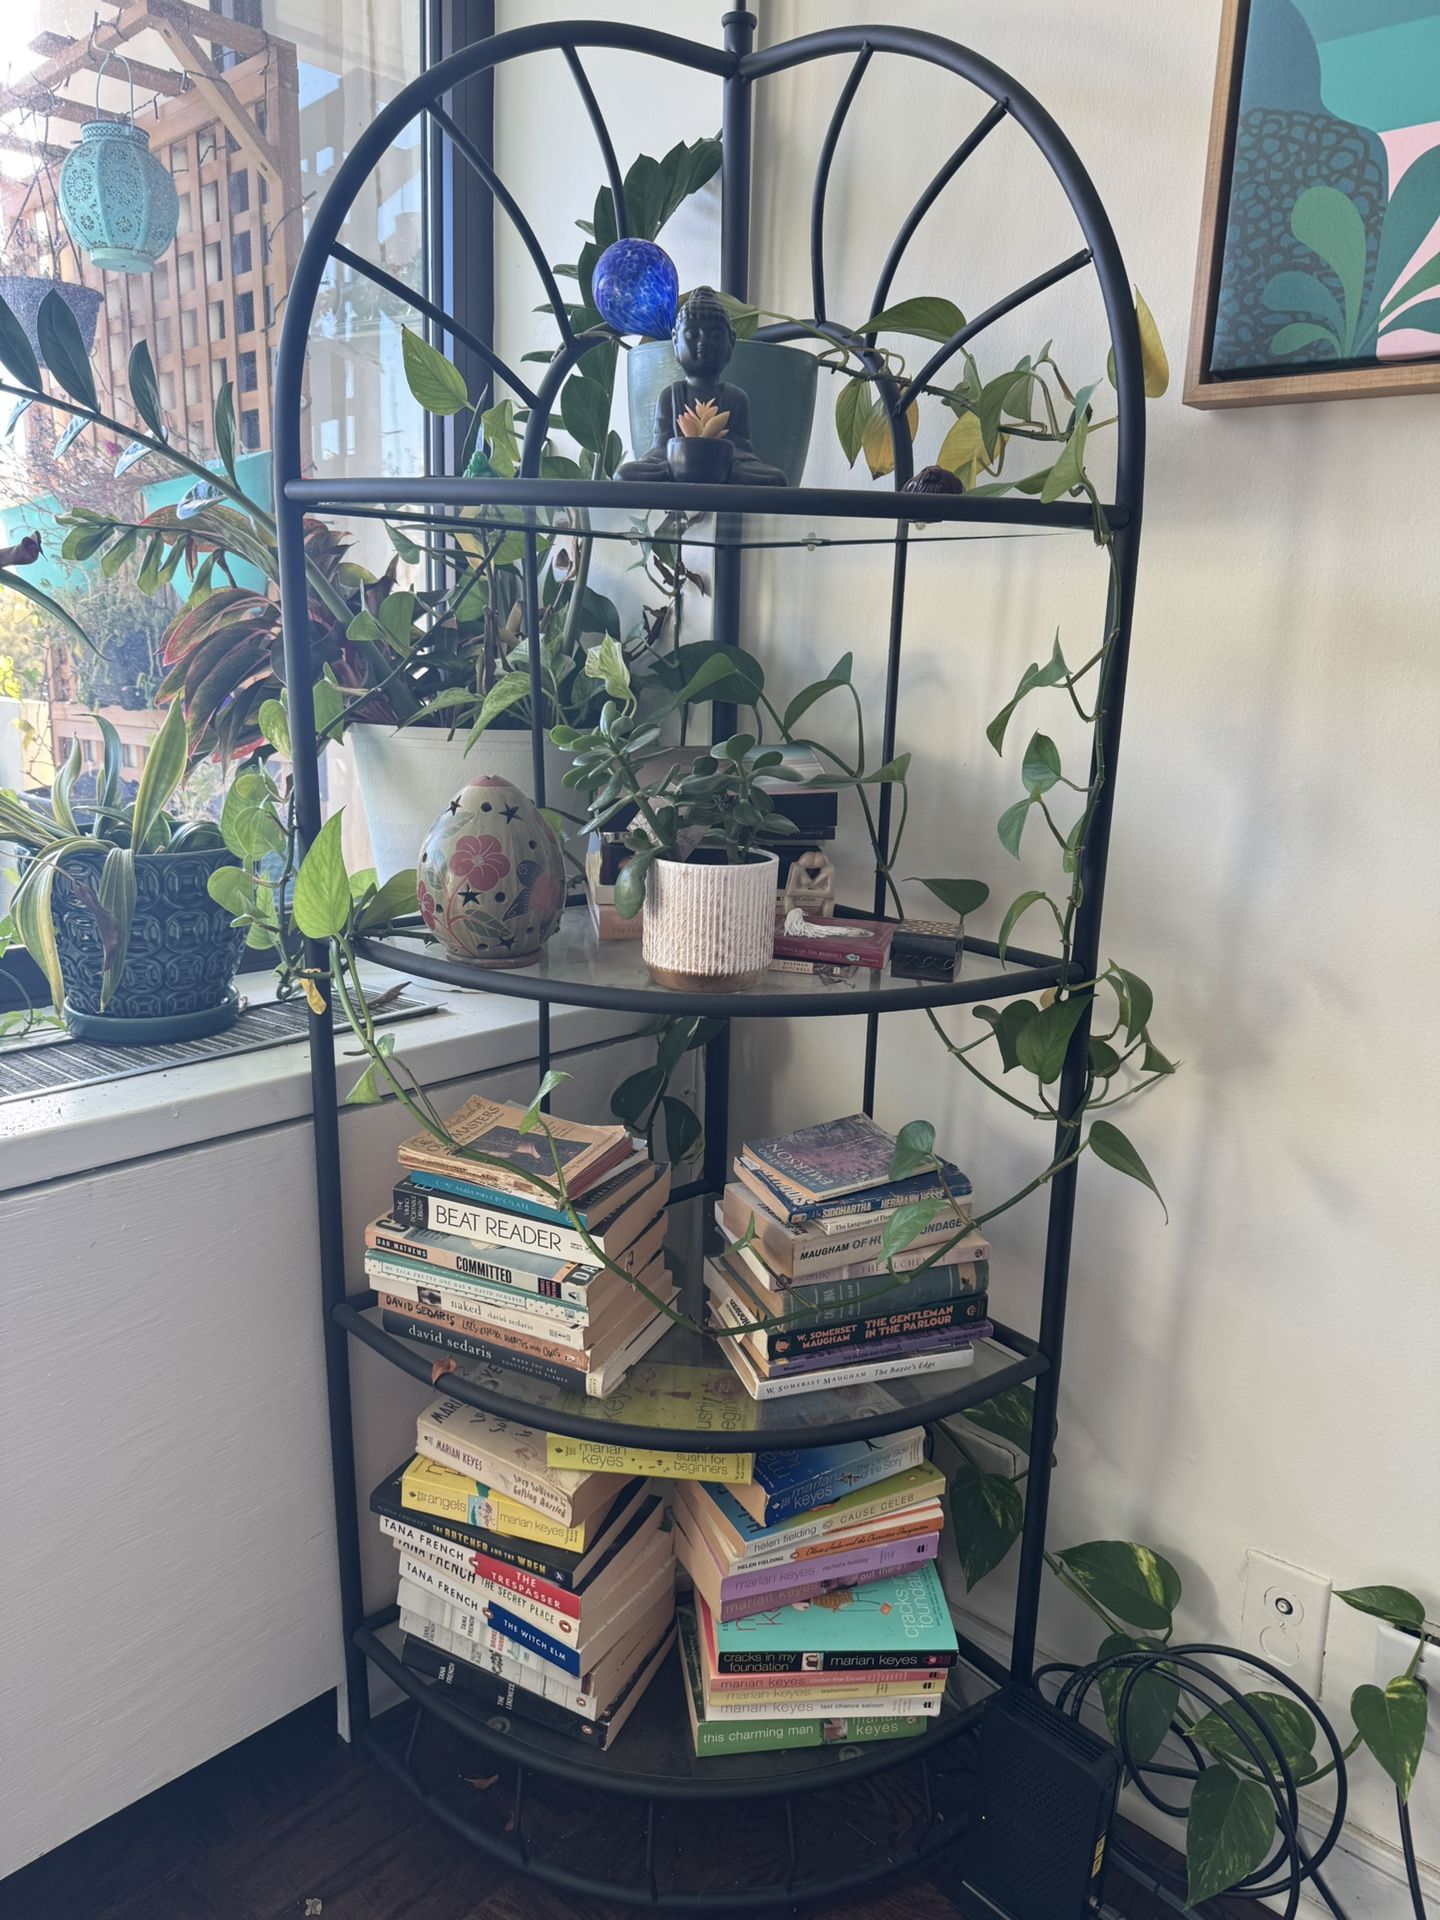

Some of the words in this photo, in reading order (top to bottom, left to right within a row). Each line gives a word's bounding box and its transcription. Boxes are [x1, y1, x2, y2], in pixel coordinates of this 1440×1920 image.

[451, 1105, 500, 1138] MASTERS
[765, 1143, 834, 1185] EMERSON
[822, 1202, 871, 1218] SIDDHARTHA
[880, 1194, 918, 1209] HERMANN
[919, 1189, 944, 1201] HESSE
[436, 1205, 480, 1232] BEAT
[486, 1217, 561, 1252] READER
[847, 1219, 873, 1230] Language
[393, 1242, 427, 1258] MATHEWS
[801, 1243, 849, 1260] MAUGHAM
[853, 1239, 868, 1250] OF
[456, 1256, 512, 1284] COMMITTED
[571, 1264, 598, 1281] DA
[386, 1295, 413, 1312] DAVID
[415, 1304, 455, 1327] SEDARIS
[451, 1300, 482, 1315] naked
[487, 1312, 507, 1322] david
[508, 1318, 533, 1330] sedaris
[864, 1318, 888, 1329] THE
[889, 1305, 954, 1324] GENTLEMAN
[810, 1324, 857, 1340] SOMERSET
[865, 1329, 876, 1339] IN
[880, 1324, 902, 1336] THE
[903, 1315, 952, 1332] PARLOUR
[409, 1325, 442, 1344] david
[447, 1339, 492, 1359] sedaris
[802, 1334, 850, 1349] MAUGHAM
[778, 1379, 820, 1393] SOMERSET
[823, 1372, 867, 1385] MAUGHAM
[874, 1368, 889, 1377] The
[889, 1363, 917, 1374] Razor's
[918, 1360, 936, 1371] Edge
[431, 1400, 464, 1424] MARI
[436, 1439, 461, 1460] MARIAN
[462, 1454, 483, 1472] KEYES
[579, 1442, 627, 1455] marian
[582, 1452, 624, 1468] keyes
[676, 1452, 706, 1463] sushi
[710, 1453, 725, 1464] for
[674, 1460, 728, 1476] beginners
[792, 1472, 838, 1498] marian
[794, 1485, 833, 1509] keyes
[513, 1486, 537, 1504] Getting
[539, 1498, 566, 1519] Married
[427, 1496, 467, 1513] angels
[500, 1512, 533, 1529] marian
[534, 1520, 564, 1537] keyes
[754, 1538, 780, 1553] helen
[783, 1525, 817, 1543] fielding
[840, 1505, 876, 1524] CAUSE
[880, 1494, 914, 1511] CELEB
[384, 1518, 414, 1540] TANA
[420, 1534, 464, 1561] FRENCH
[432, 1524, 443, 1533] THE
[444, 1527, 488, 1552] BUTCHER
[491, 1547, 503, 1556] AND
[504, 1552, 515, 1561] THE
[517, 1555, 546, 1574] WREN
[737, 1561, 757, 1571] HELEN
[758, 1556, 784, 1567] FIELDING
[491, 1571, 561, 1609] TRESPASSER
[516, 1571, 537, 1588] THE
[736, 1574, 775, 1591] marian
[780, 1567, 815, 1582] keyes
[726, 1594, 773, 1614] marian
[779, 1583, 818, 1599] keyes
[860, 1569, 876, 1581] out
[406, 1561, 434, 1585] TANA
[438, 1581, 478, 1611] FRENCH
[503, 1618, 518, 1633] THE
[521, 1630, 547, 1650] WITCH
[549, 1648, 566, 1661] ELM
[497, 1586, 527, 1608] SECRET
[530, 1603, 555, 1625] PLACE
[895, 1588, 920, 1638] cracks
[723, 1653, 761, 1662] cracks
[765, 1652, 775, 1662] in
[781, 1652, 797, 1665] my
[730, 1662, 789, 1673] foundation
[830, 1656, 875, 1666] marian
[878, 1654, 917, 1668] keyes
[438, 1666, 446, 1681] TANA
[446, 1662, 456, 1685] FRENCH
[720, 1679, 763, 1689] marian
[768, 1677, 806, 1688] keyes
[506, 1683, 515, 1710] LIKENESS
[726, 1689, 770, 1701] marian
[773, 1687, 812, 1700] keyes
[720, 1704, 767, 1714] marian
[773, 1700, 814, 1715] keyes
[703, 1732, 725, 1744] this
[728, 1727, 784, 1742] charming
[788, 1725, 814, 1736] man
[856, 1723, 899, 1736] keyes
